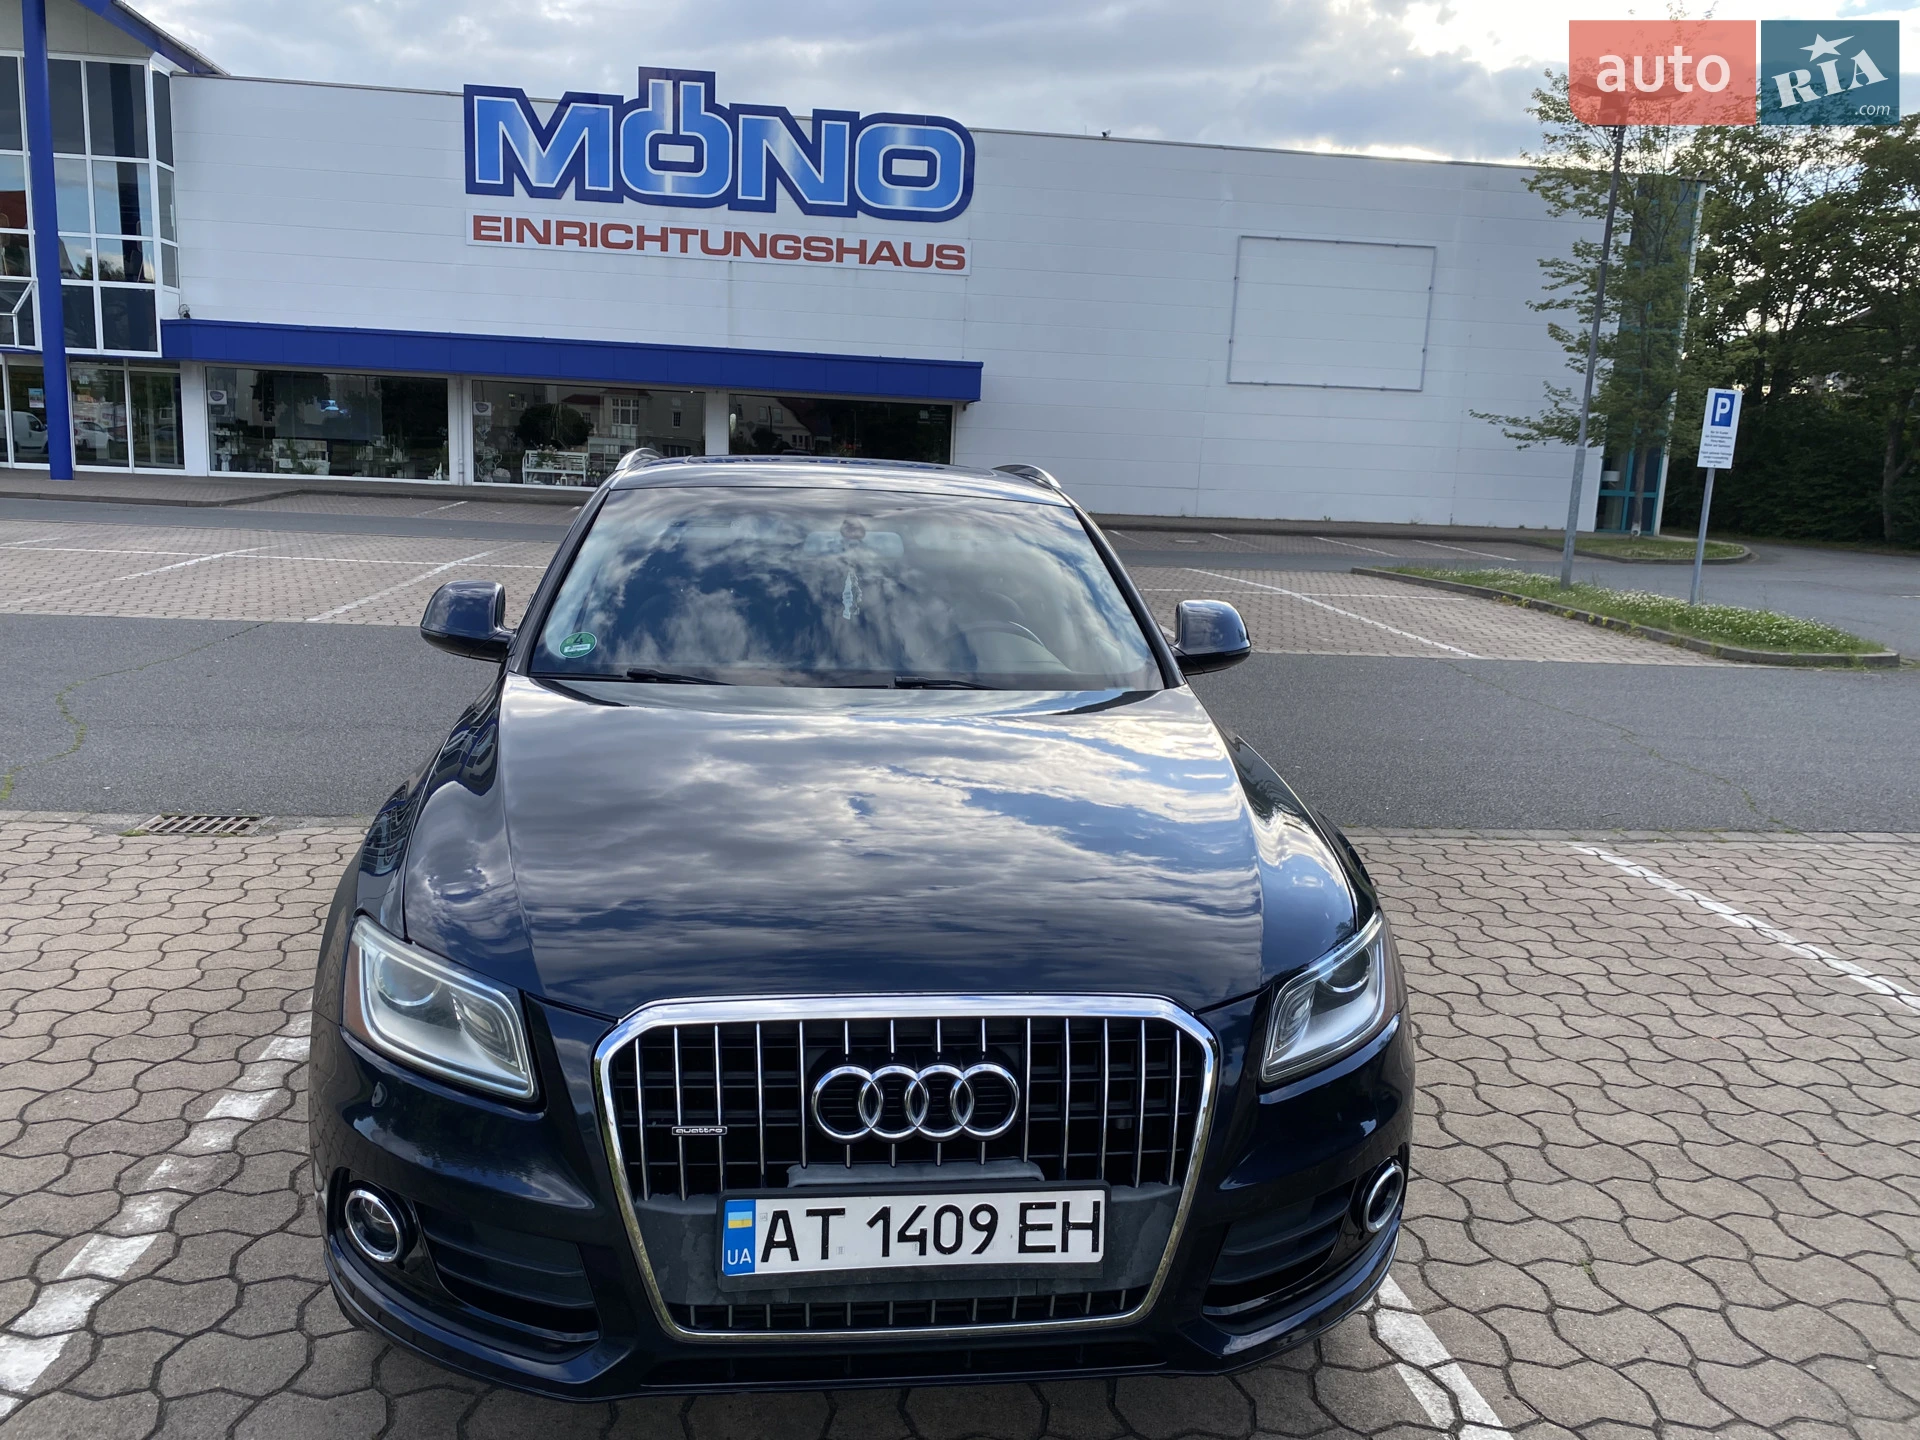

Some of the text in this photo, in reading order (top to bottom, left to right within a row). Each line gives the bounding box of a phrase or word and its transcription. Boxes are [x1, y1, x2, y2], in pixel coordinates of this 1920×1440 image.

[464, 66, 976, 222] MÖNO
[473, 214, 966, 271] EINRICHTUNGSHAUS
[1715, 397, 1731, 422] P
[676, 1127, 723, 1135] quattro
[761, 1200, 1101, 1263] AT 1409 EH
[727, 1248, 752, 1266] UA
